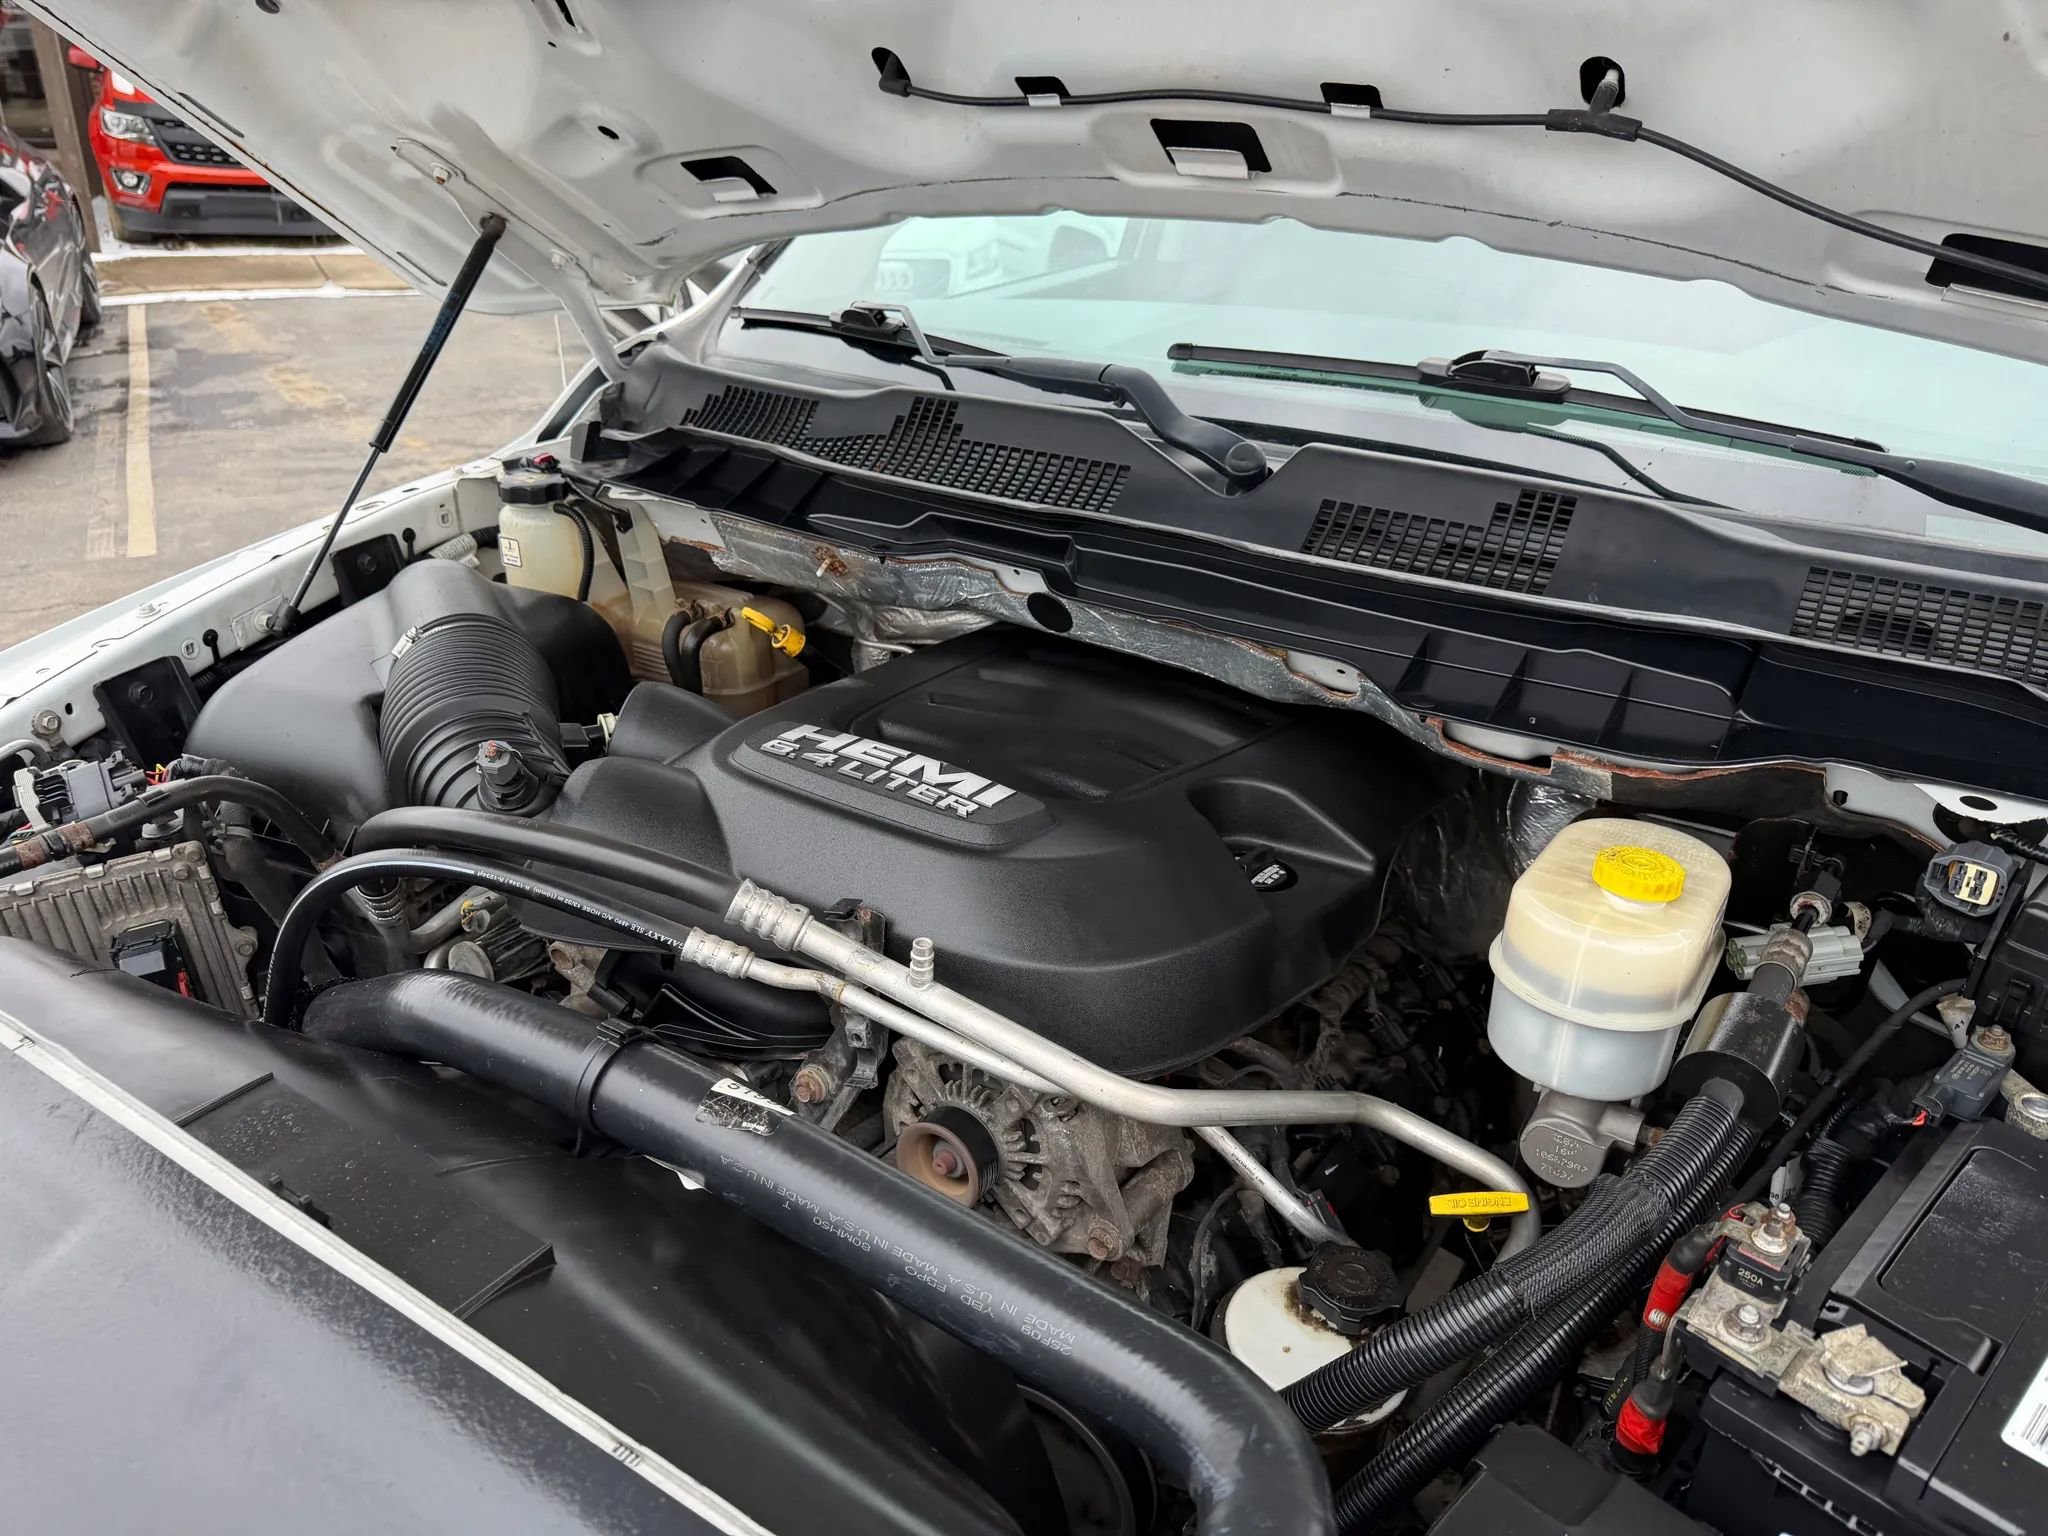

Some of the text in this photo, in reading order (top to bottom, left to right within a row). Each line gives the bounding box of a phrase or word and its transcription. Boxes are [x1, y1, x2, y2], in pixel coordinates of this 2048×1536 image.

[777, 724, 1017, 809] HEMI
[760, 739, 980, 819] 6.4 LITER
[582, 905, 601, 916] HOSE
[630, 923, 645, 934] SLE
[645, 930, 685, 950] GALAXY
[760, 1176, 774, 1189] IN
[776, 1185, 820, 1213] MADE
[1447, 1197, 1511, 1208] ENGINE OIL
[873, 1235, 889, 1250] IN
[892, 1245, 938, 1275] MADE
[1738, 1268, 1763, 1287] 250A
[1000, 1300, 1018, 1316] IN
[1023, 1312, 1075, 1344] MADE
